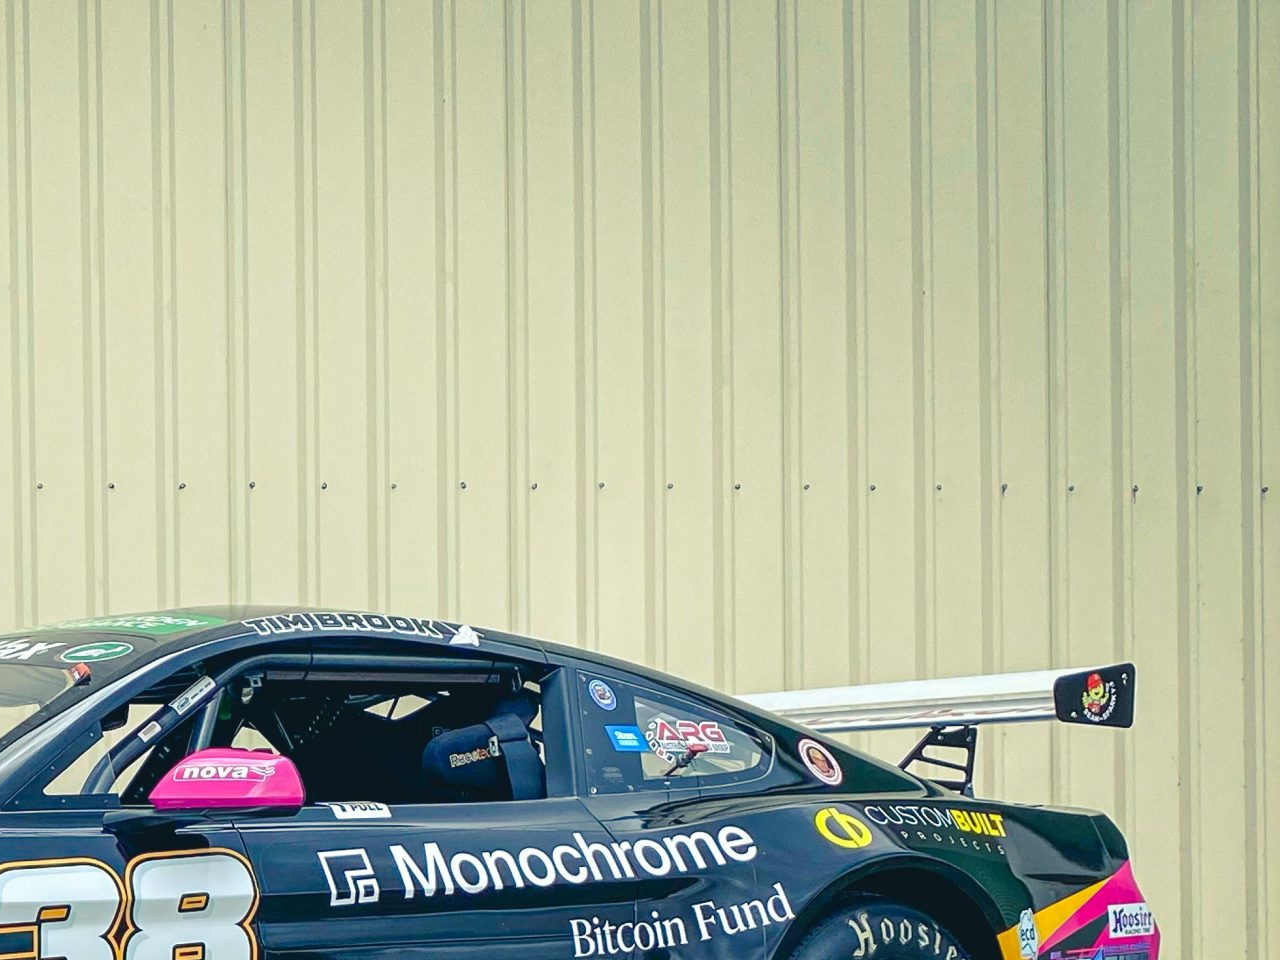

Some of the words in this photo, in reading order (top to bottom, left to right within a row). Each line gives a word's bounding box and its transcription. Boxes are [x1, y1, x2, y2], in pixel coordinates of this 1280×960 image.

[241, 612, 313, 636] TIM
[182, 765, 250, 781] nova
[900, 829, 1006, 856] PROJECTS
[388, 823, 759, 900] Monochrome
[568, 907, 688, 958] Bitcoin
[694, 881, 797, 942] Fund
[1020, 922, 1036, 941] ecd
